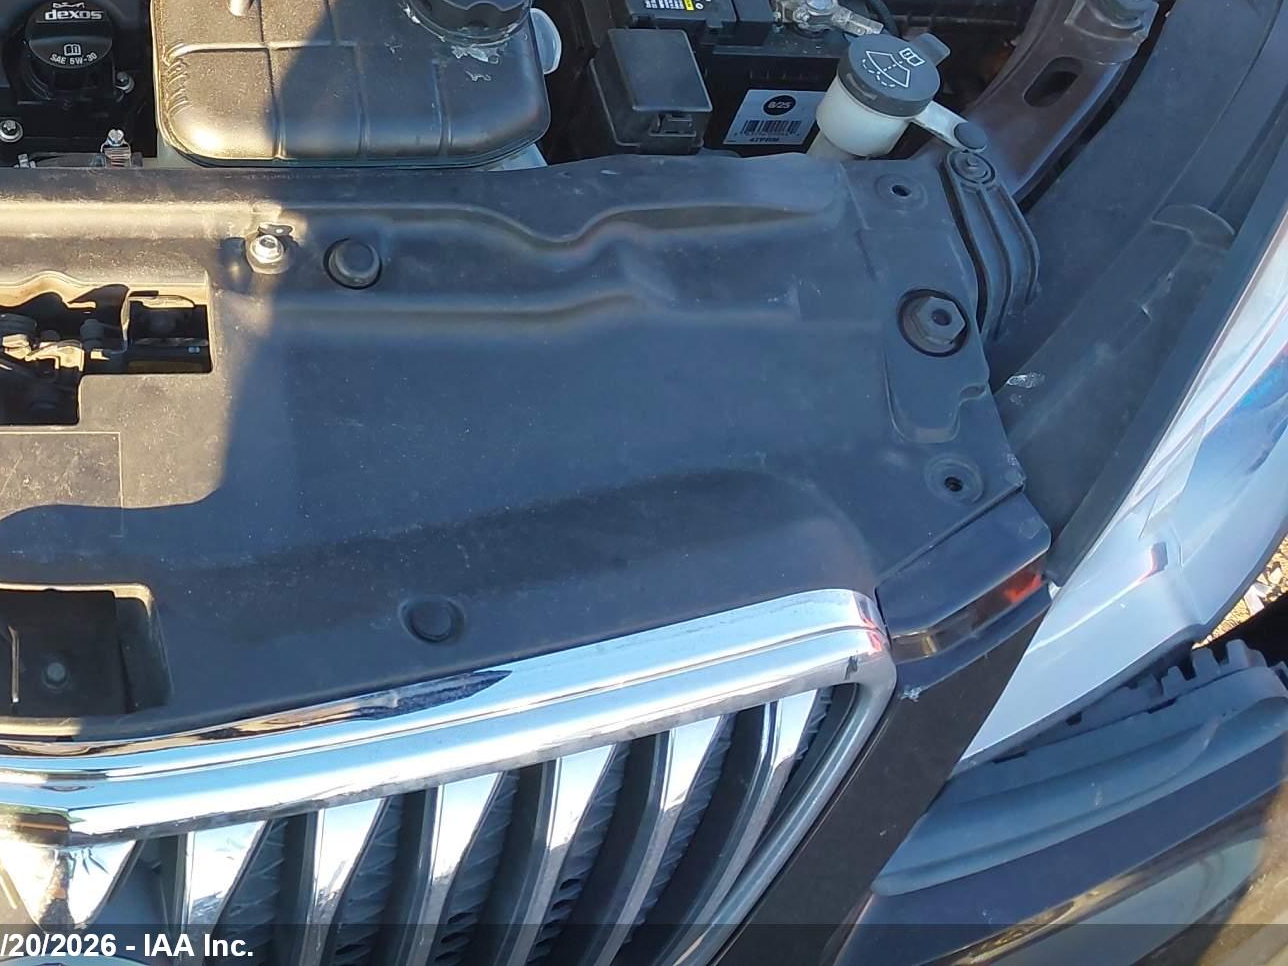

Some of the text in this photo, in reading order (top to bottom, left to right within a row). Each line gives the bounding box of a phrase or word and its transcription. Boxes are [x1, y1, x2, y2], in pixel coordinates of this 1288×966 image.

[44, 9, 104, 21] dexos
[50, 52, 98, 65] SAE 5W-30
